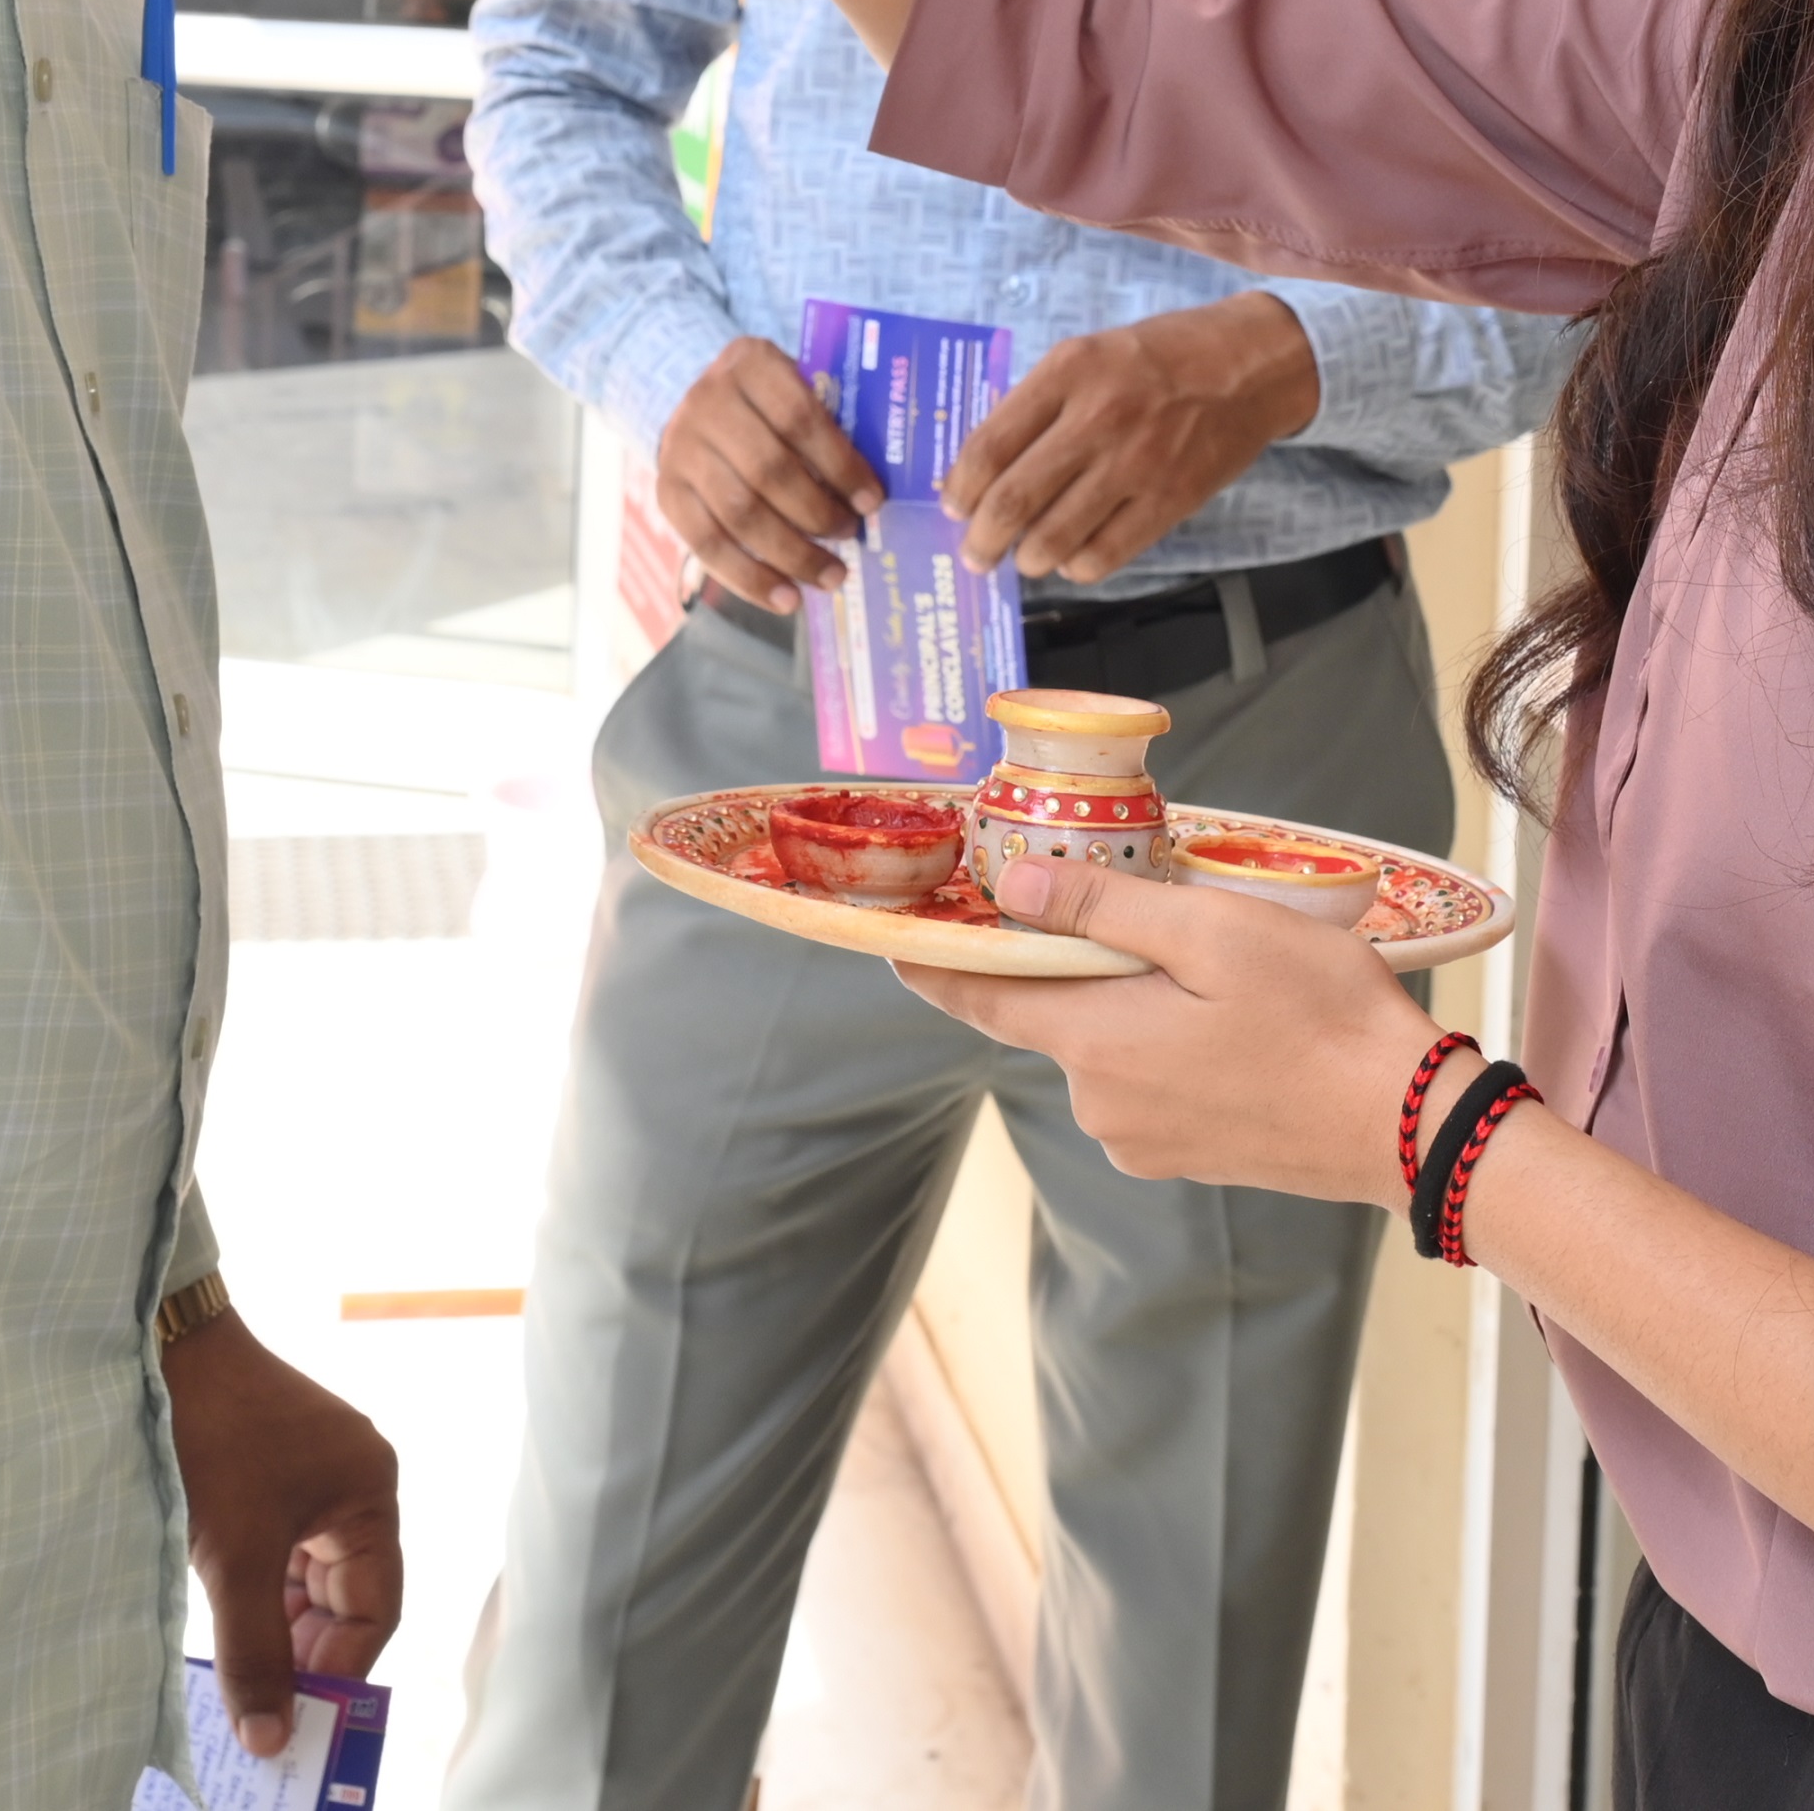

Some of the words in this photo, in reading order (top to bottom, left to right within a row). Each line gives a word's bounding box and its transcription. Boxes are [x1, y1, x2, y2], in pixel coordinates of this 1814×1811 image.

[889, 355, 909, 403] PASS
[886, 403, 906, 465] ENTRY
[914, 592, 945, 722] PRINCIPAL'S
[937, 609, 967, 724] CONCLAVE
